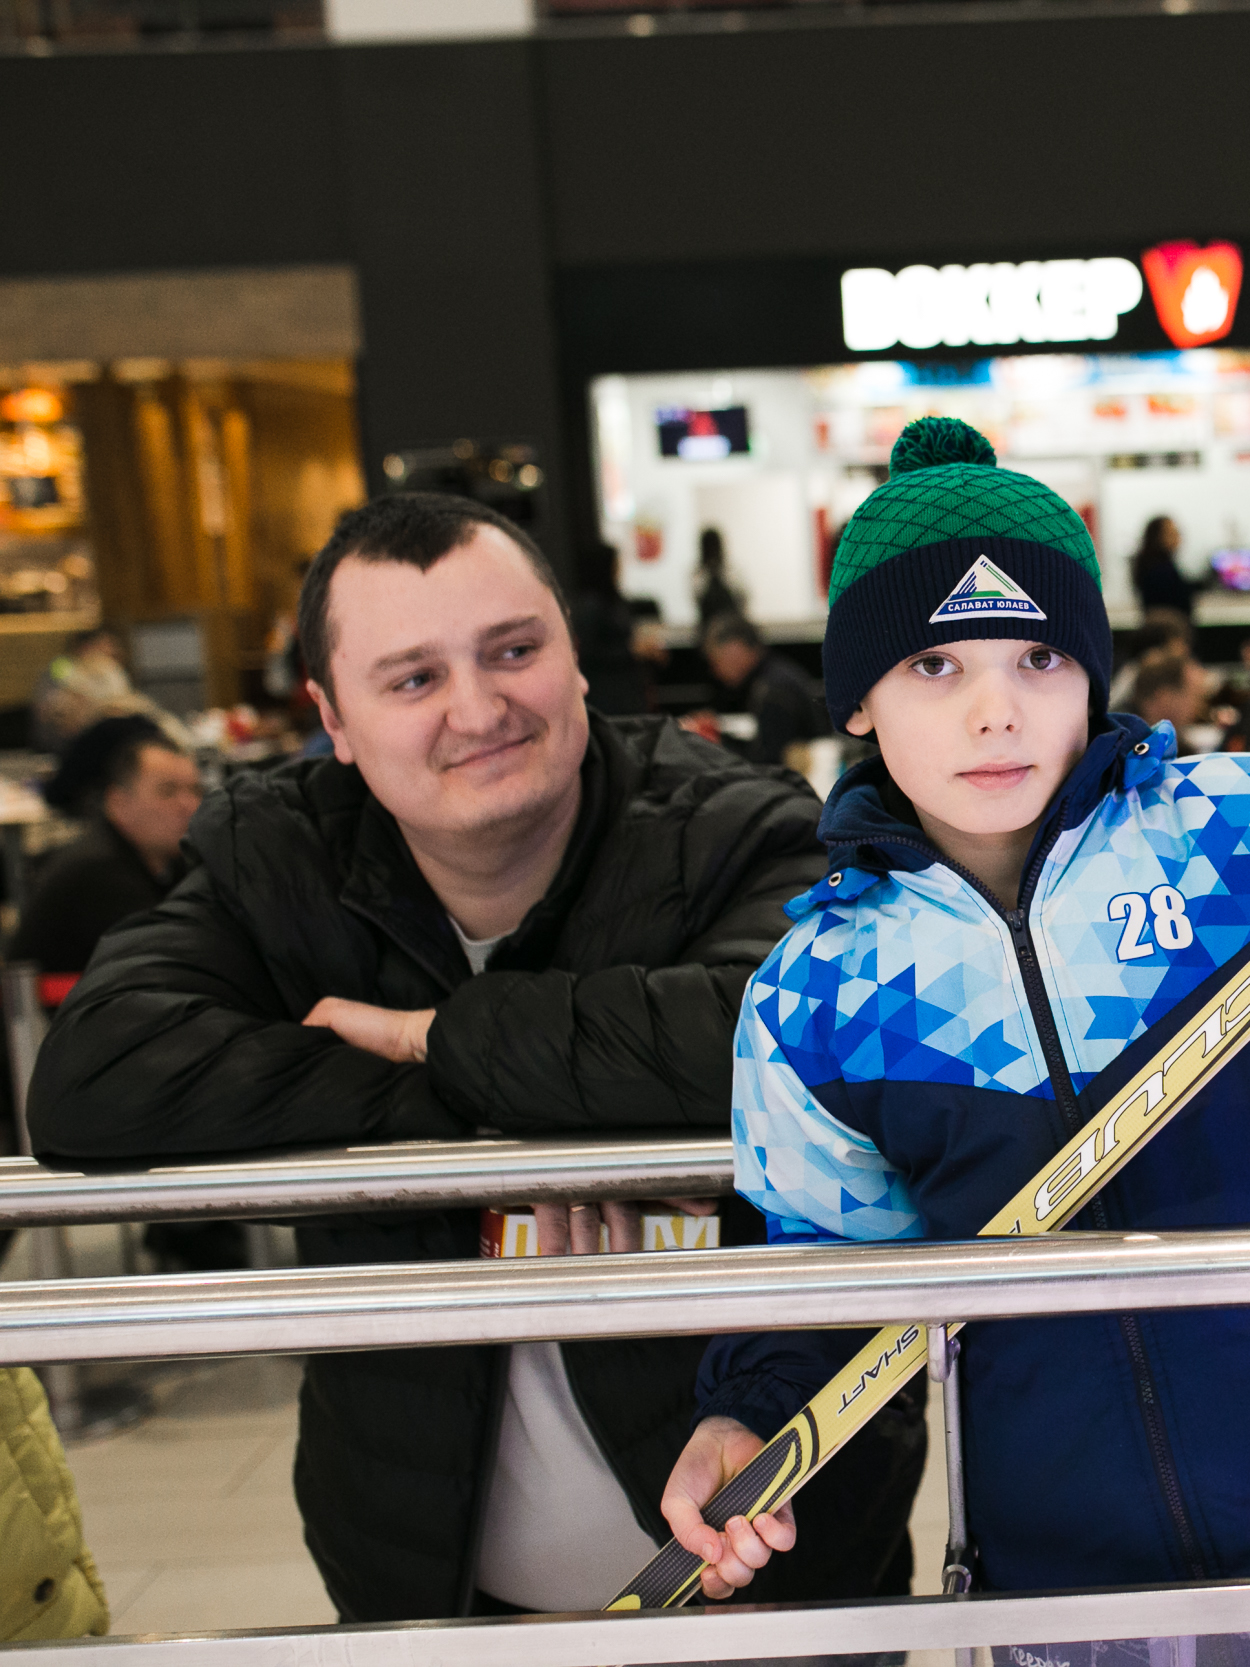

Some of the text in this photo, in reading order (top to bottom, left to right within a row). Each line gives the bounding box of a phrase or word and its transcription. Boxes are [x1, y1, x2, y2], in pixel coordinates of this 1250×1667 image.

[948, 600, 1030, 612] САЛАВАТ ЮЛАЕВ
[1107, 883, 1194, 963] 28
[837, 1324, 920, 1416] SHAFT
